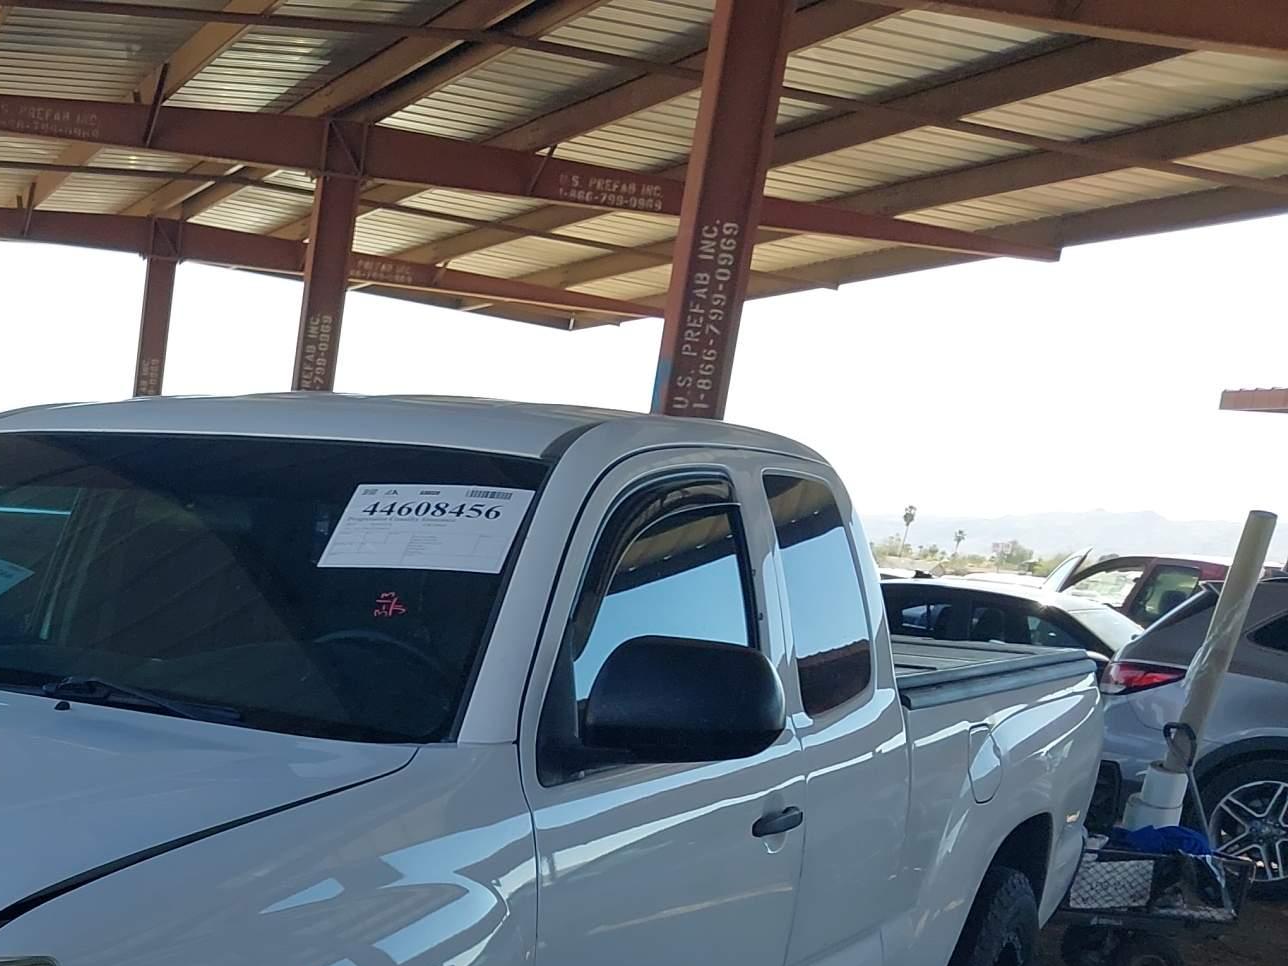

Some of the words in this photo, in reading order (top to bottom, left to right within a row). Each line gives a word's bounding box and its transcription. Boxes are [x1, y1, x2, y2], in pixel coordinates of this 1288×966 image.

[588, 177, 636, 194] PREFAB
[698, 219, 720, 261] INC.
[682, 272, 710, 356] PREFAB
[692, 222, 739, 409] 1-866-799-0969
[672, 369, 695, 408] U.S.
[362, 501, 505, 520] 44608456
